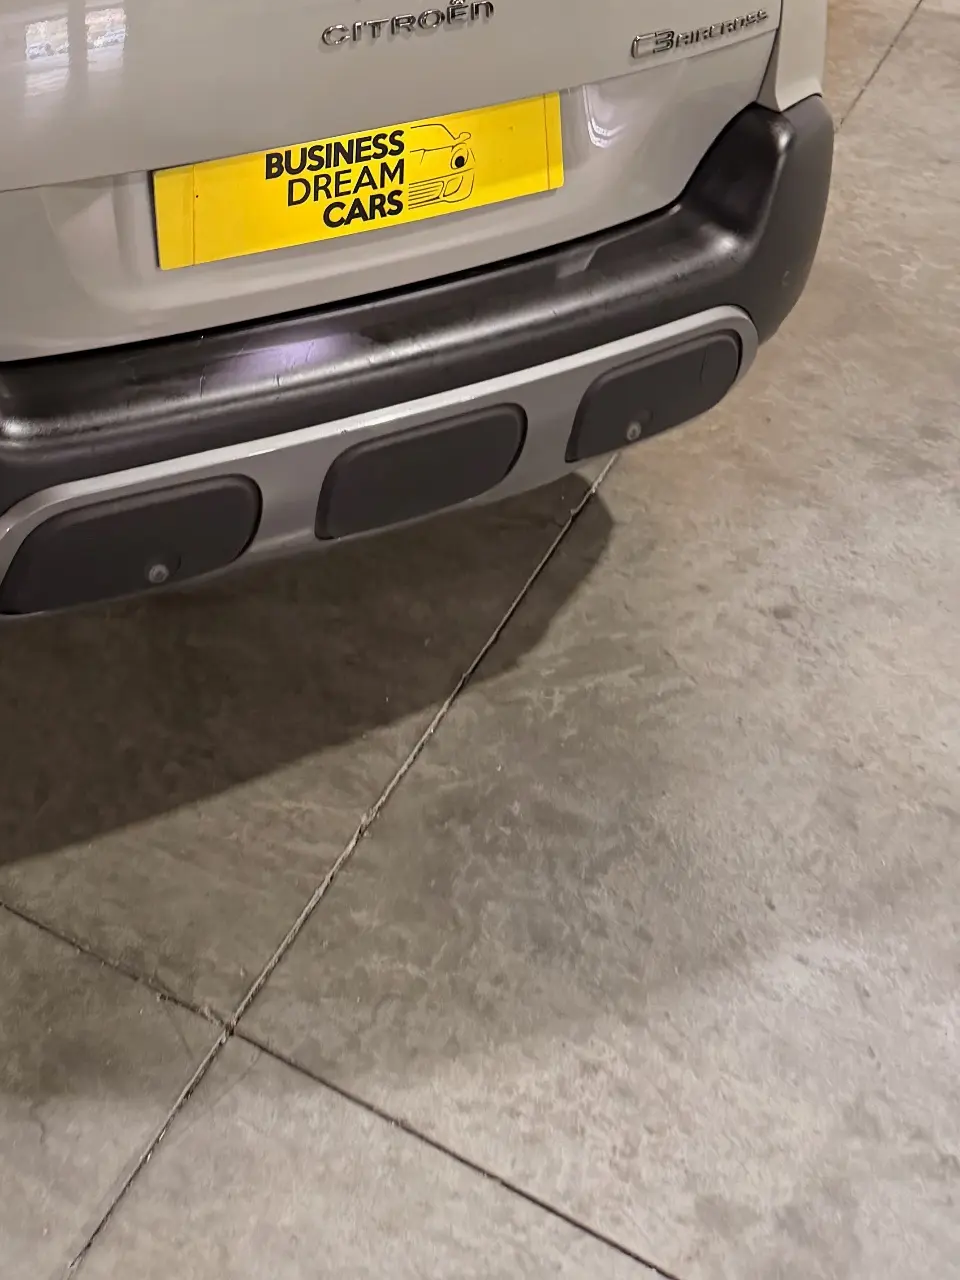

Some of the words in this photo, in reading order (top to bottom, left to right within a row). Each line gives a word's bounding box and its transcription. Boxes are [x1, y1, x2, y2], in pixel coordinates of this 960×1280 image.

[631, 30, 674, 58] C3
[264, 130, 405, 179] BUSINESS
[287, 158, 405, 206] DREAM
[322, 189, 403, 228] CARS
